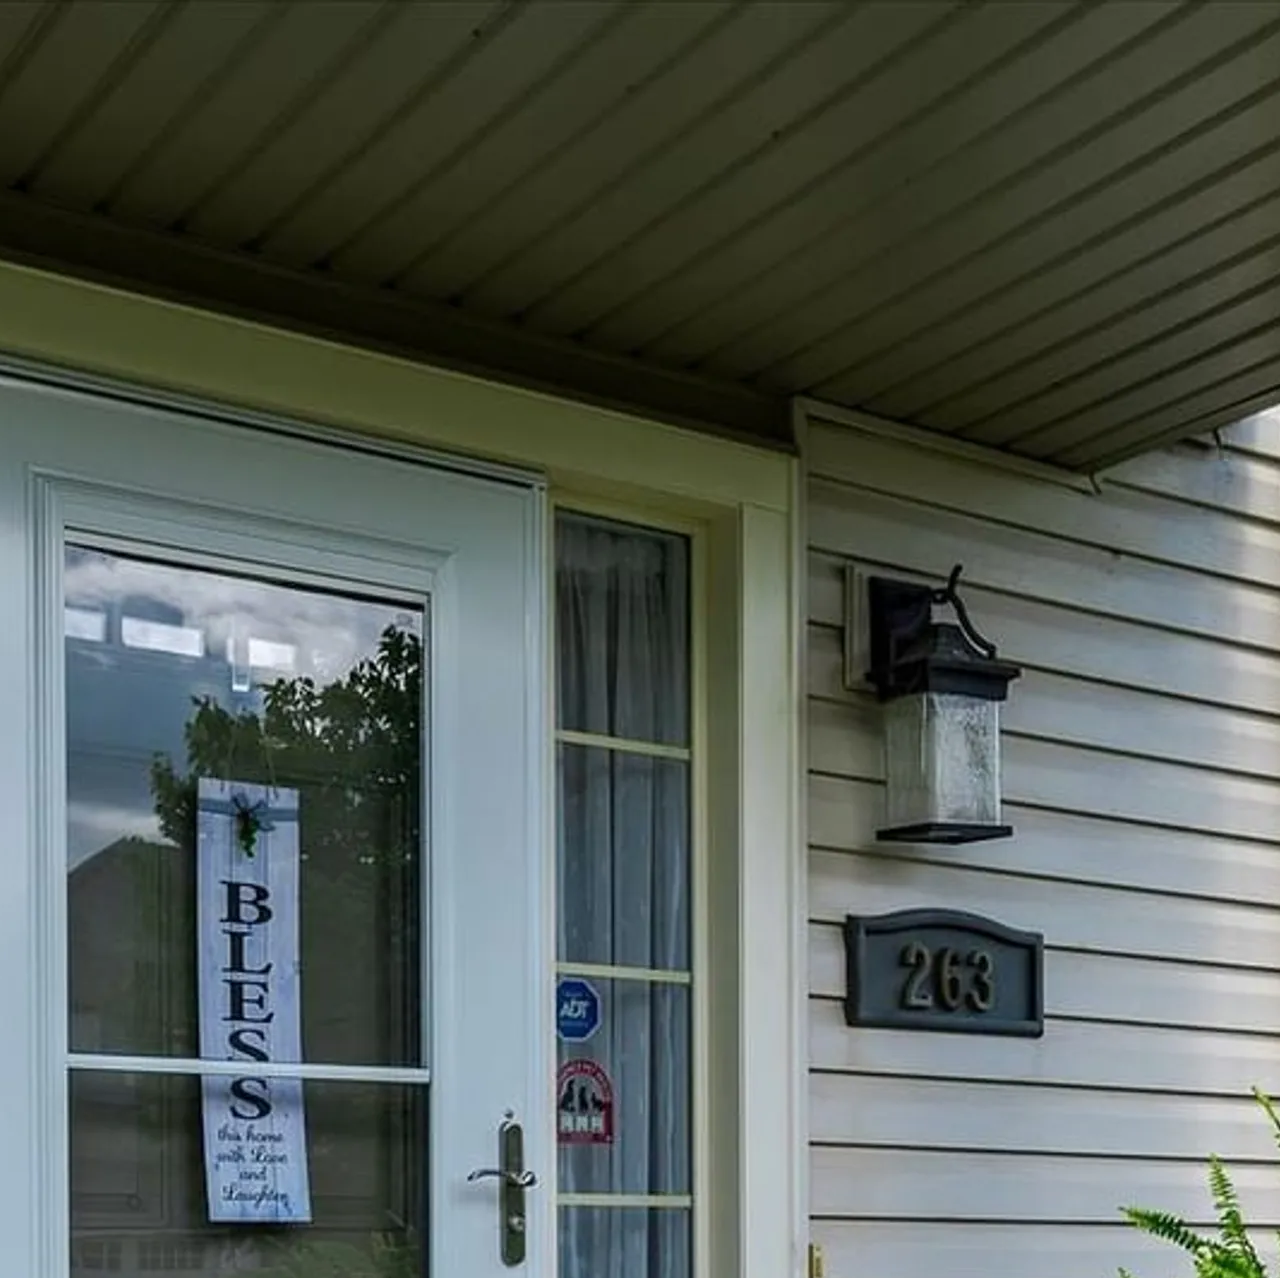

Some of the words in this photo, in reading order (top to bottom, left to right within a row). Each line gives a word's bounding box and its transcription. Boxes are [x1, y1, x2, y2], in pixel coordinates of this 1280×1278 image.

[900, 941, 994, 1012] 263
[219, 880, 273, 1120] BLESS
[559, 999, 590, 1019] ADT
[246, 1123, 283, 1142] home
[239, 1166, 267, 1181] and
